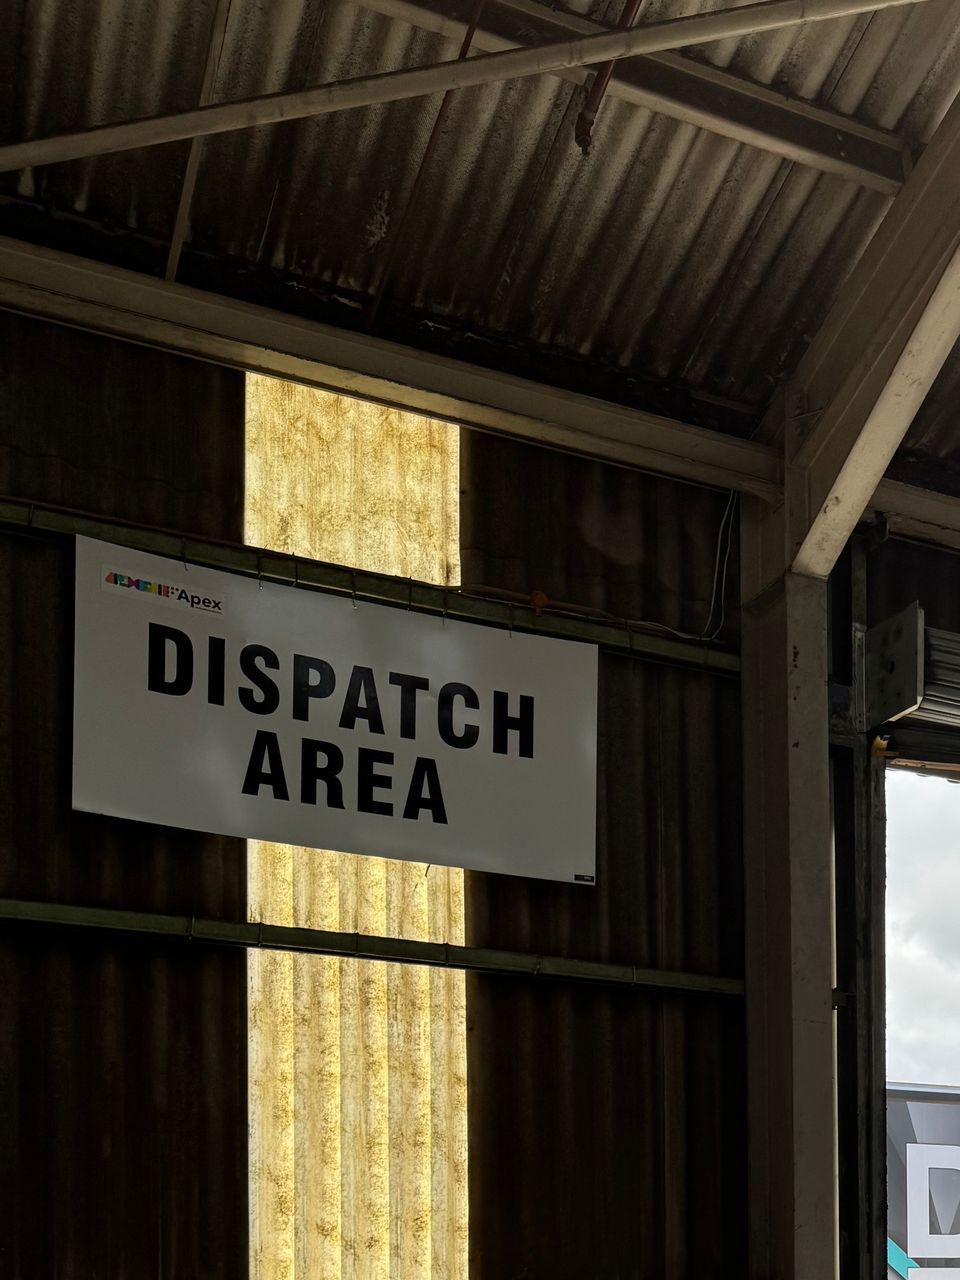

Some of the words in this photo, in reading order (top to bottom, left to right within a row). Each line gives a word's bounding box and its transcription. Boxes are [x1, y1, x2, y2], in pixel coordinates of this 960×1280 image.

[177, 589, 222, 611] Apex
[147, 622, 535, 759] DISPATCH
[241, 729, 449, 825] AREA
